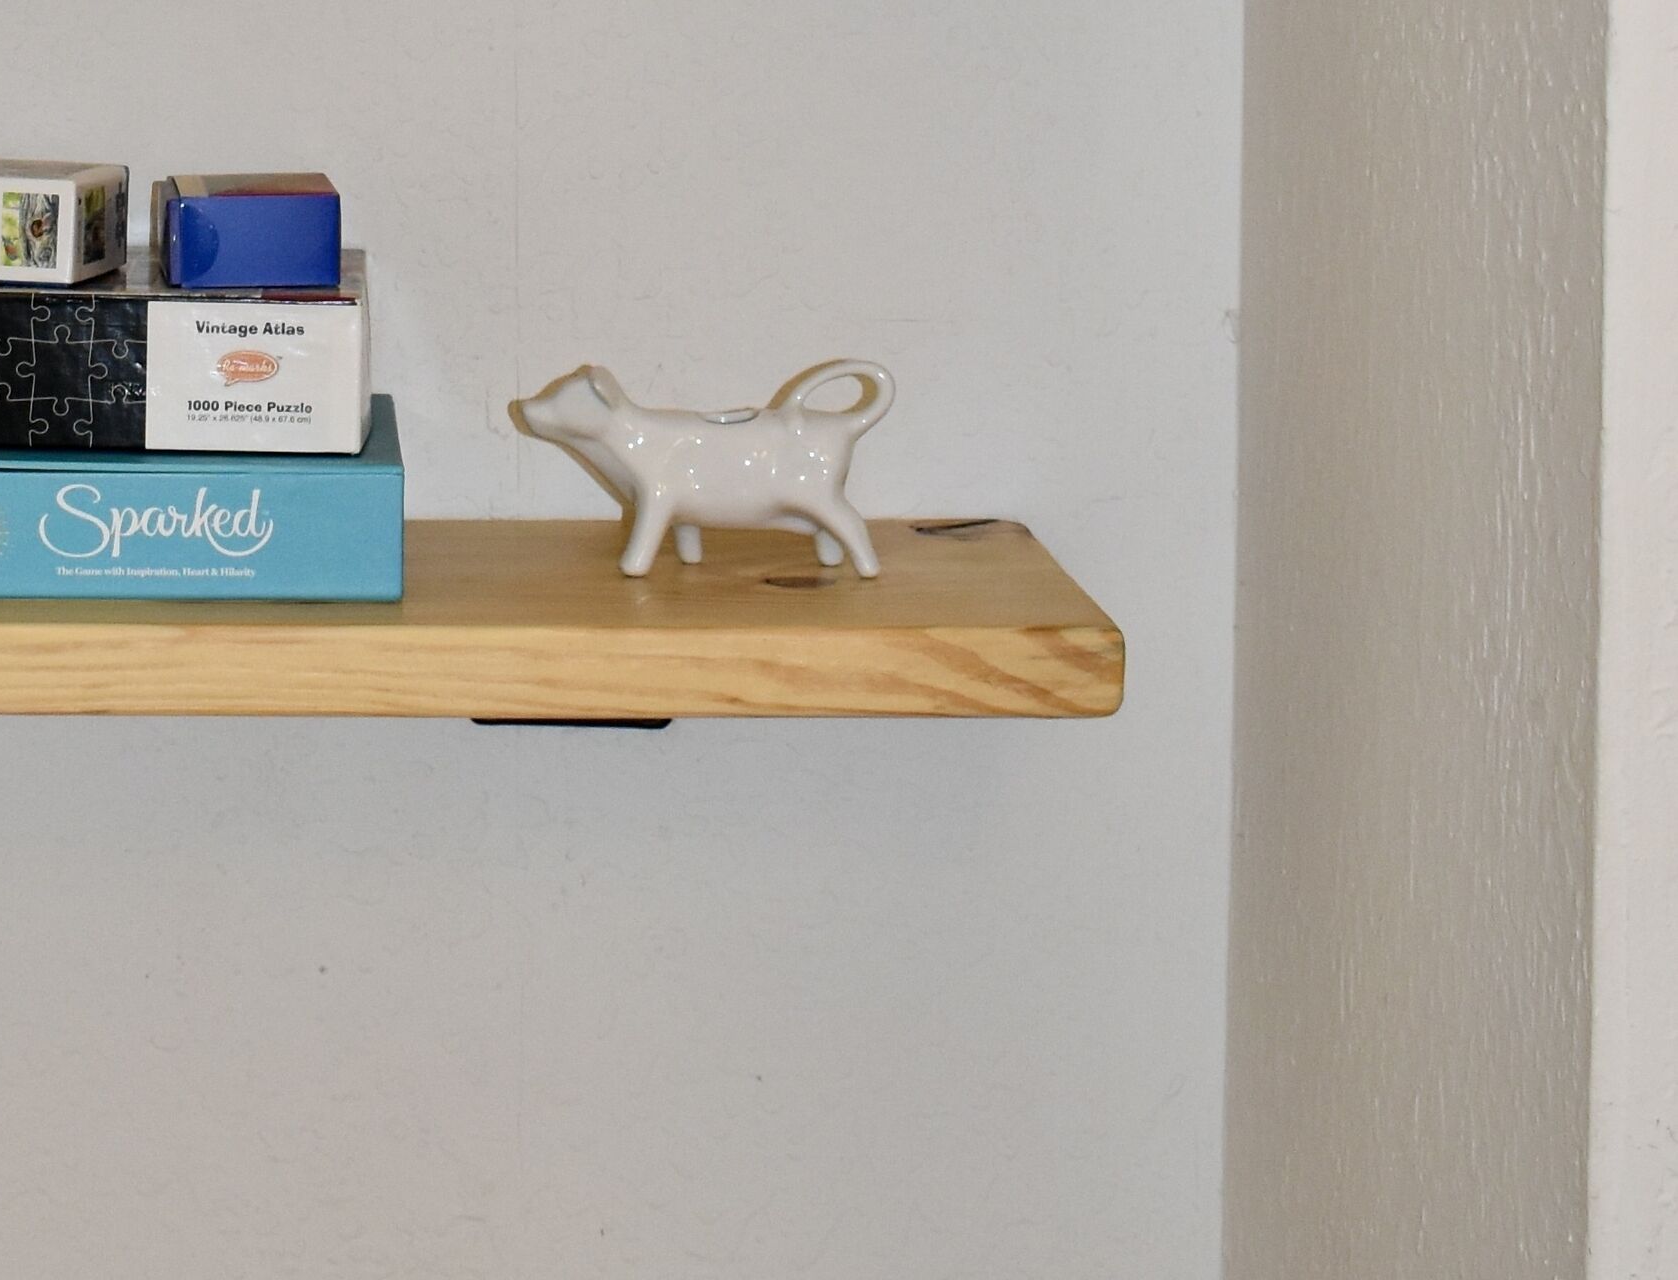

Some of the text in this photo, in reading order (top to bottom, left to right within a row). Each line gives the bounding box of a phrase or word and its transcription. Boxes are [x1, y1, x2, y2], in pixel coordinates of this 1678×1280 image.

[196, 320, 305, 339] Vintage Atlas
[187, 400, 312, 414] 1000 Piece Puzzle
[38, 483, 274, 558] Sparked
[56, 566, 74, 576] The
[75, 567, 102, 576] Game
[104, 566, 126, 576] with
[126, 566, 180, 578] Inspiration,
[182, 567, 210, 576] Heart
[220, 567, 256, 578] Hilarity
